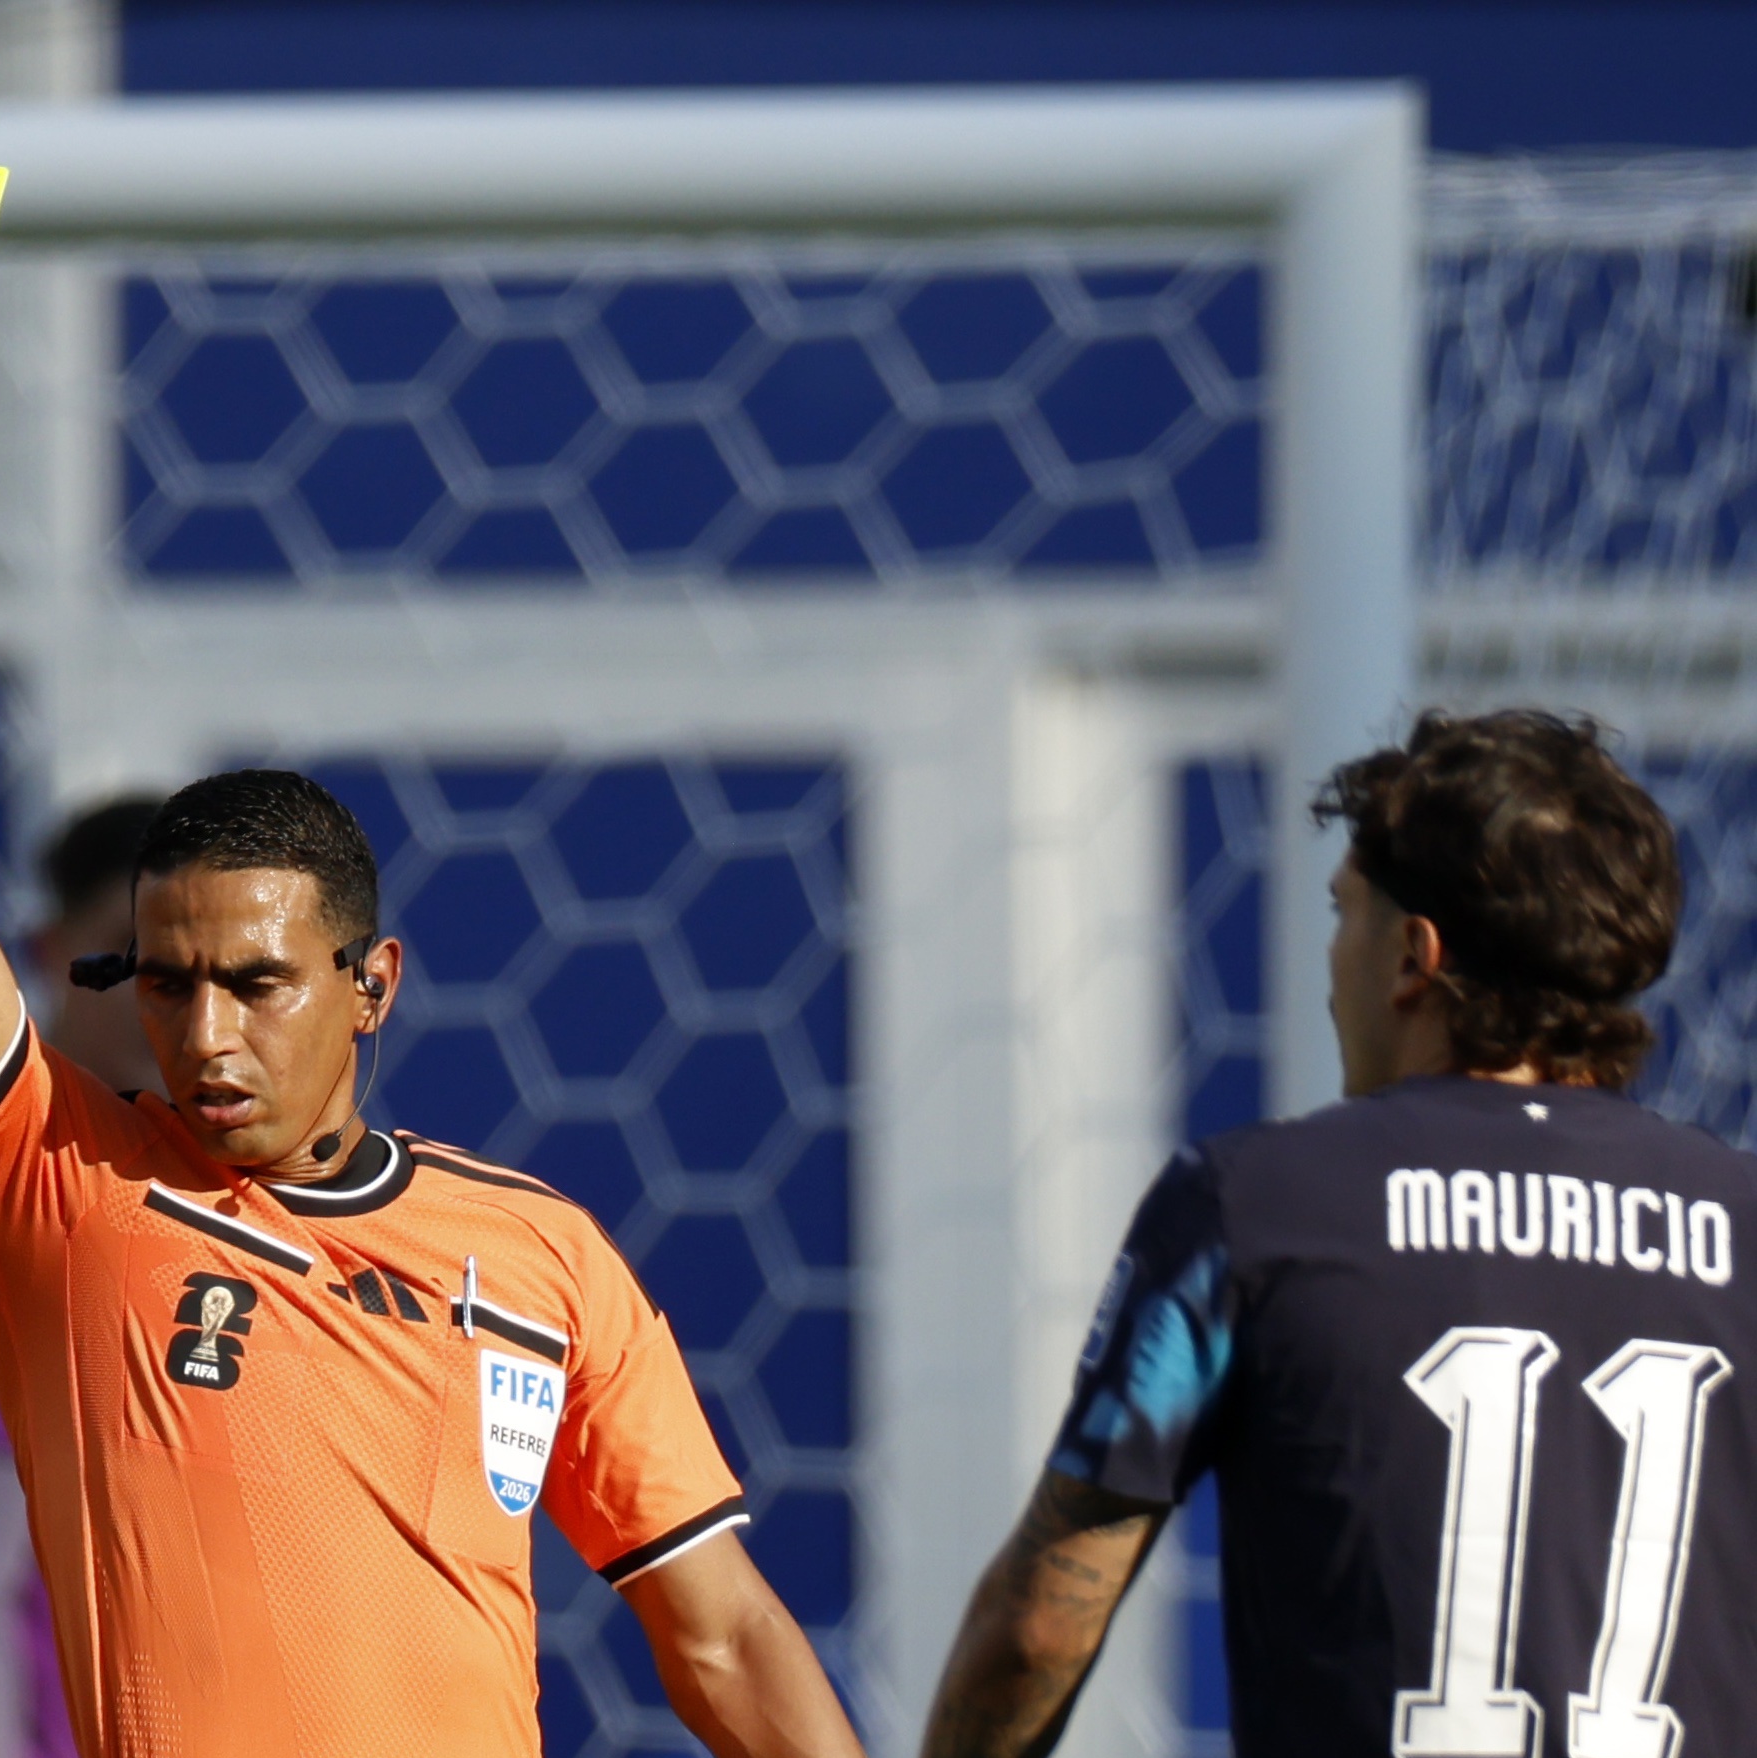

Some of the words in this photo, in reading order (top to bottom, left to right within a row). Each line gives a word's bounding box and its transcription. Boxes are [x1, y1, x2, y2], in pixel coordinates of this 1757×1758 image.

[1386, 1168, 1734, 1286] MAURICIO
[184, 1361, 220, 1382] FIFA
[490, 1361, 555, 1414] FIFA
[499, 1478, 532, 1504] 2026
